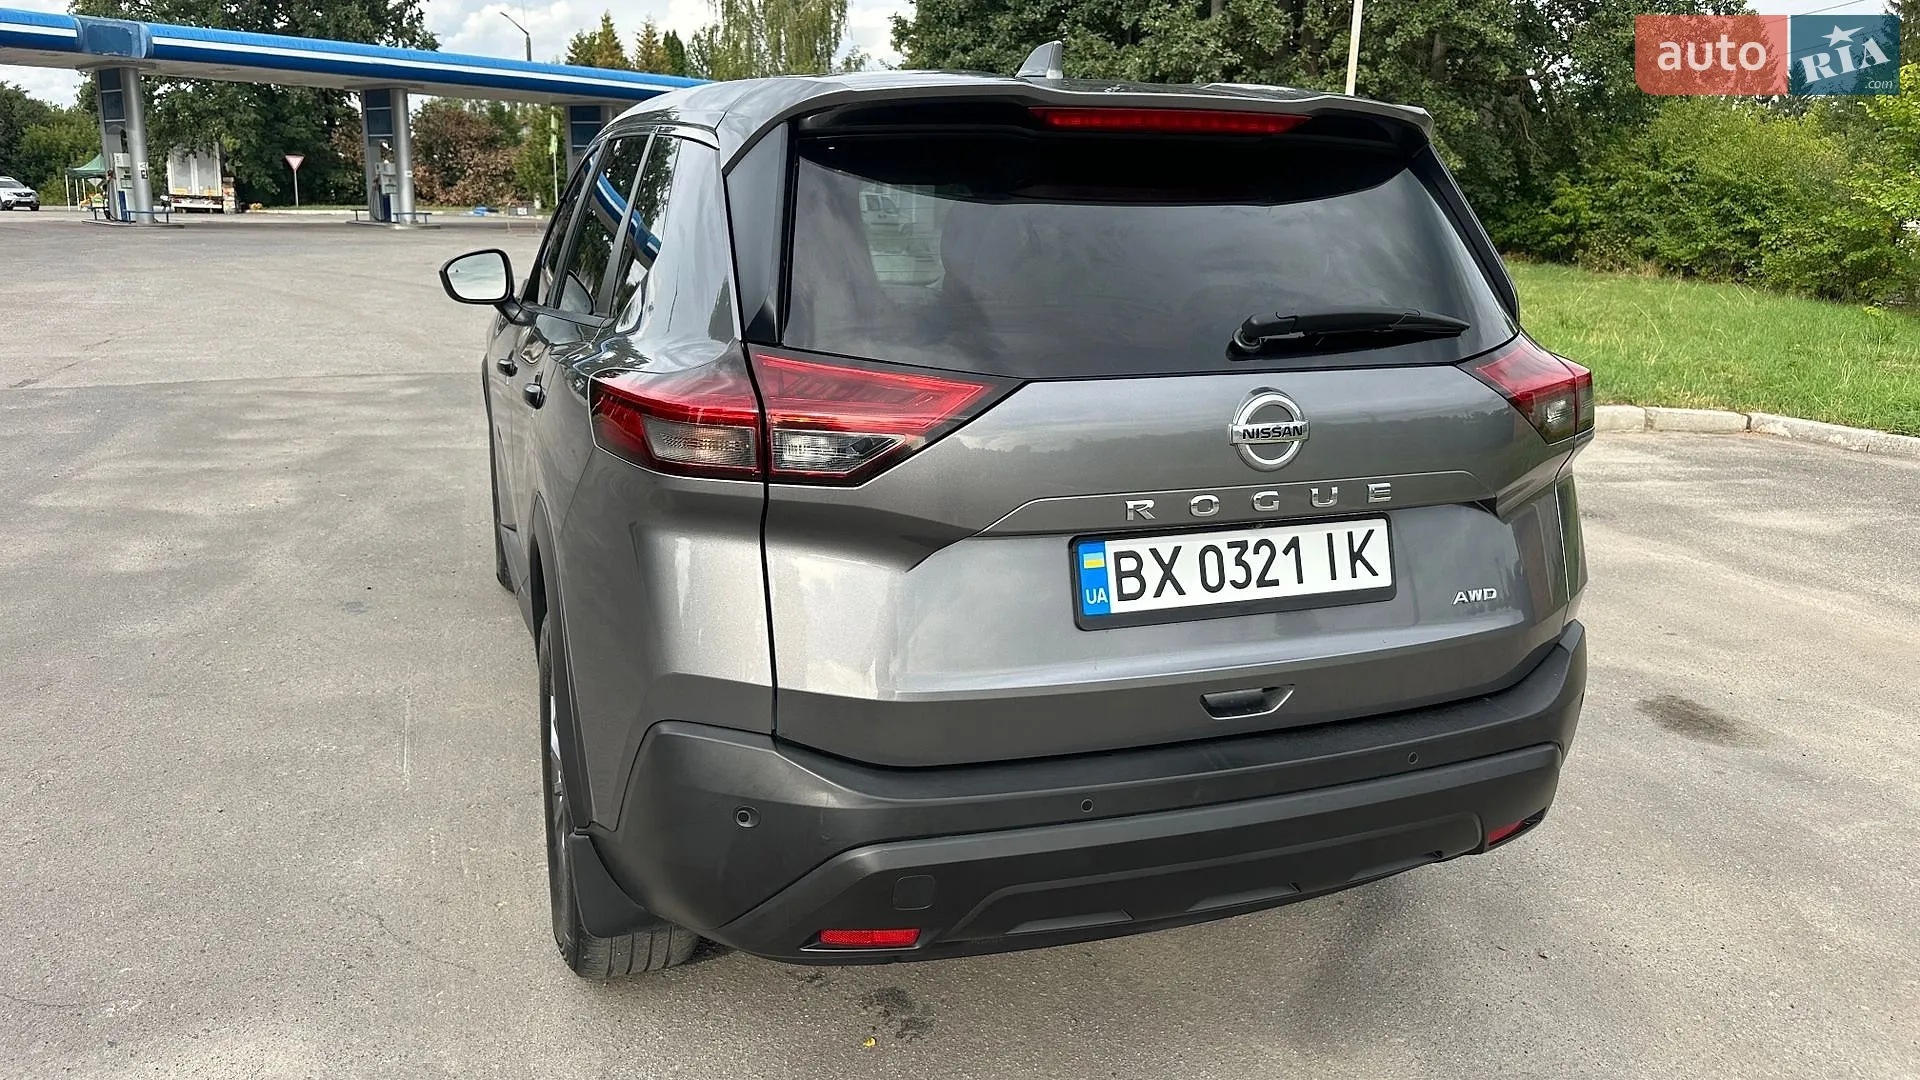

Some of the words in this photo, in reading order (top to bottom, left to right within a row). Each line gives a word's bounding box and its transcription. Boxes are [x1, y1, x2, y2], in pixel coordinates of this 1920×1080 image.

[1242, 425, 1303, 439] NISSAN
[1125, 482, 1391, 521] ROGUE
[1113, 545, 1187, 602] BX
[1199, 535, 1304, 593] 0321
[1326, 529, 1379, 580] IK
[1086, 587, 1109, 605] UA
[1452, 587, 1497, 605] AWD
